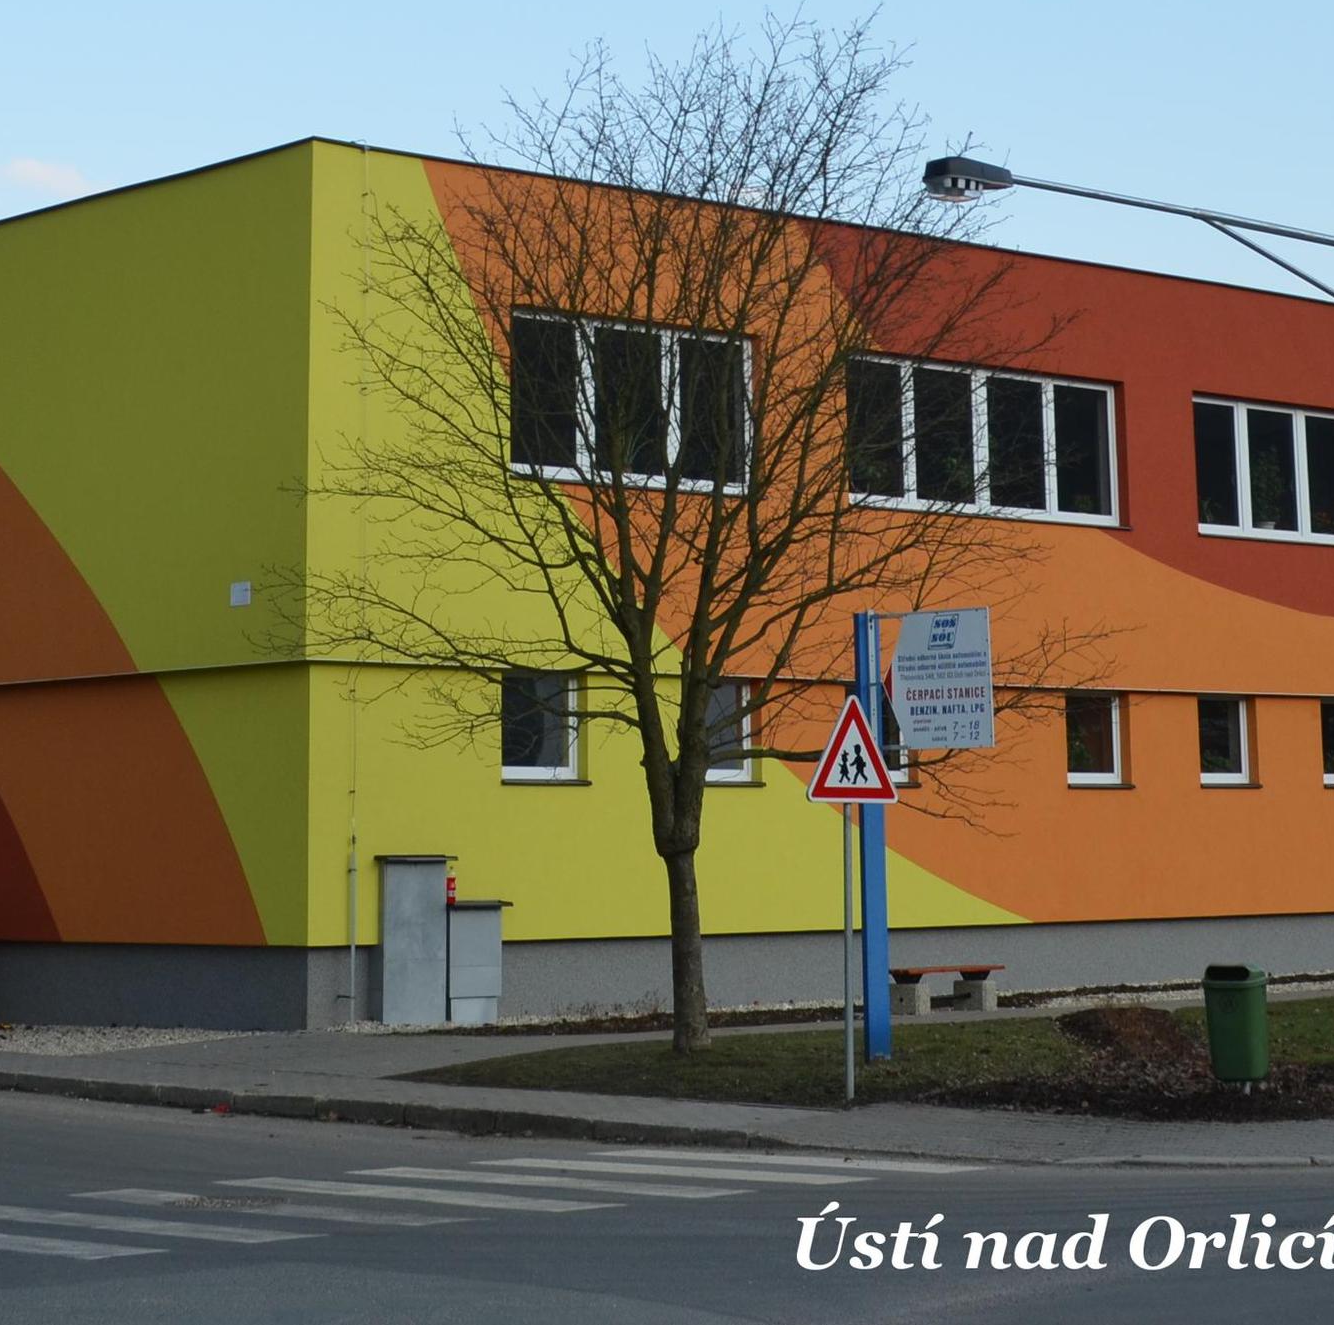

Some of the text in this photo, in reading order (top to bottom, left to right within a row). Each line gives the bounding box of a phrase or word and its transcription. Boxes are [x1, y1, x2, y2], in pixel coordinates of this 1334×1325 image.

[906, 685, 986, 701] ČERPACÍ STANICE
[971, 703, 985, 713] LPG
[953, 721, 959, 731] 7
[969, 720, 980, 731] 18
[953, 732, 959, 741] 7
[969, 731, 980, 741] 12
